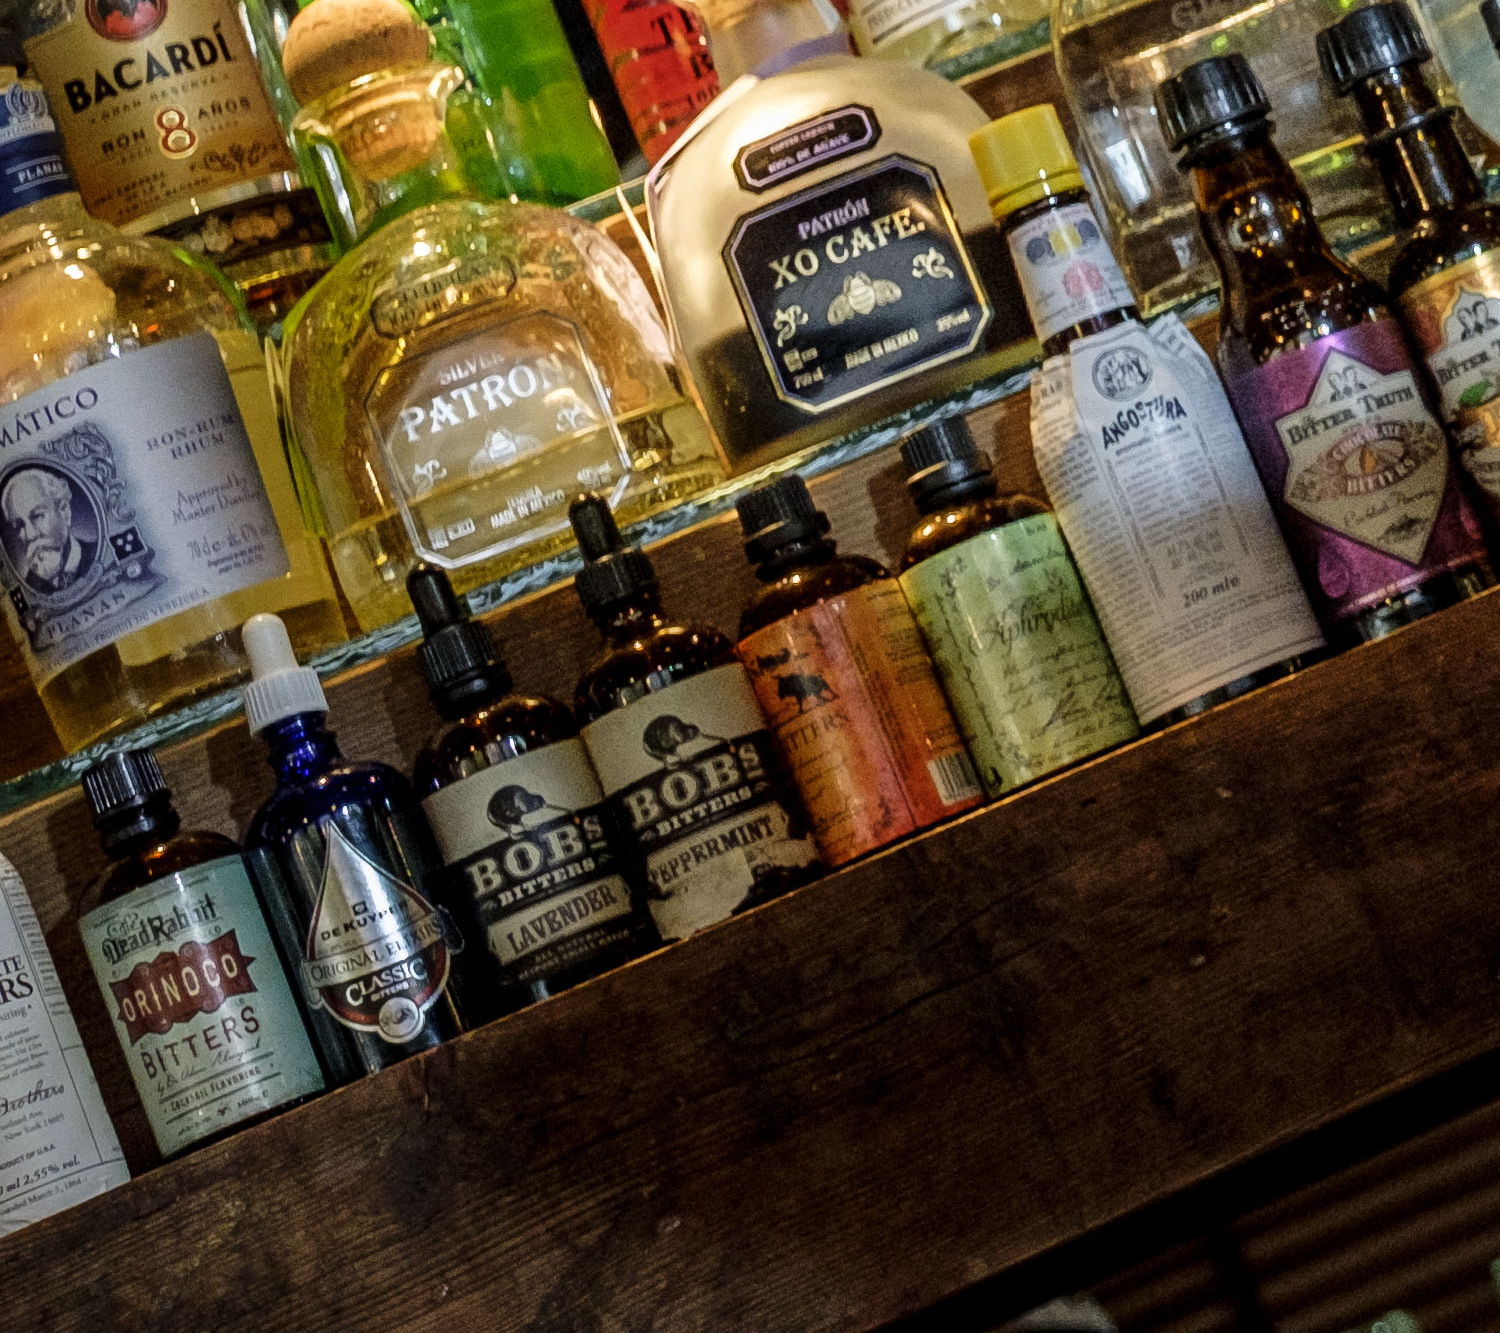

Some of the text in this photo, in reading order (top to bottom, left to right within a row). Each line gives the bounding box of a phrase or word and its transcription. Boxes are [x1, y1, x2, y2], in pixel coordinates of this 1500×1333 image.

[63, 21, 234, 115] BACARDÍ
[156, 103, 201, 161] 8
[797, 197, 870, 241] PATRÓN
[769, 249, 820, 290] XO
[1101, 394, 1188, 450] ANGOSTURA
[656, 784, 753, 837] BITTERS
[498, 856, 596, 908] BITTERS
[506, 883, 617, 955] LAVENDER
[122, 953, 238, 1022] ORINOCO
[345, 957, 428, 1006] CLASSIC
[140, 1005, 260, 1079] BITTERS
